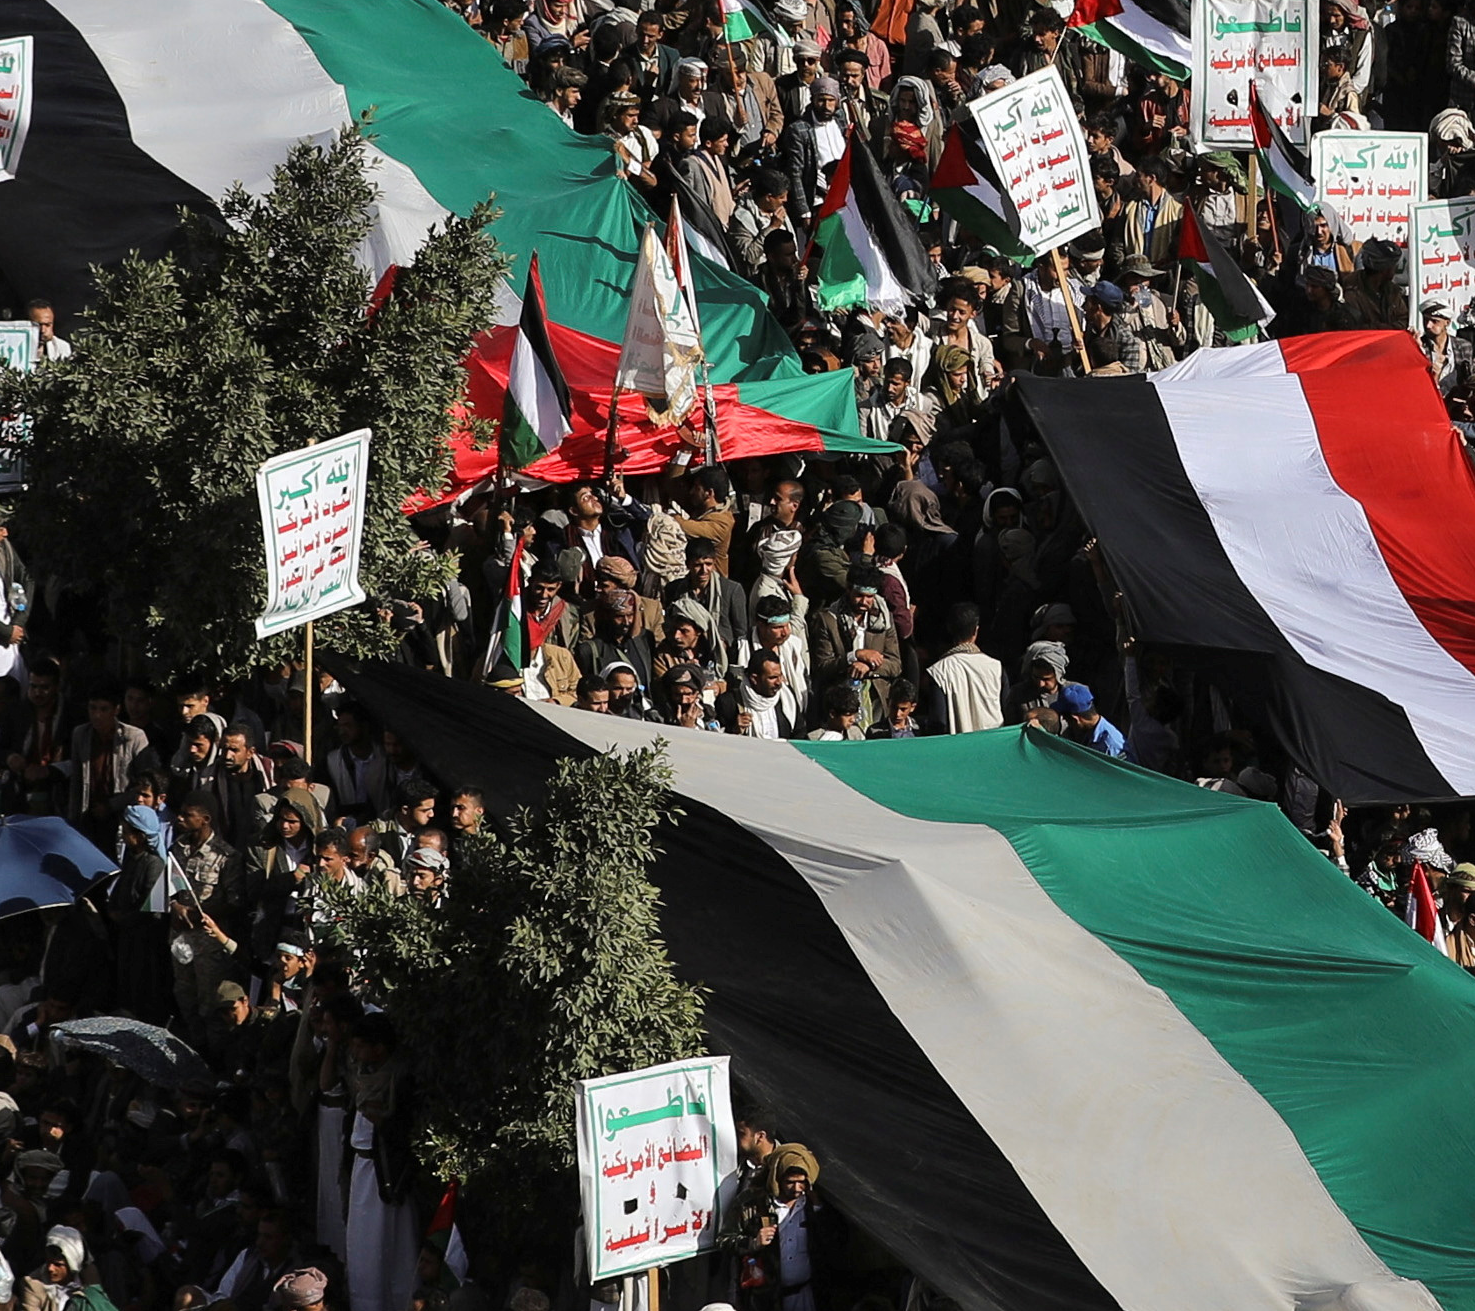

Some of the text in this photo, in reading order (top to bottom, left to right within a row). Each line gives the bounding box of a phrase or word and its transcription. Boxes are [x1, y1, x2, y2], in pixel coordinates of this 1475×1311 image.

[598, 1086, 707, 1141] قاطعوا
[602, 1135, 707, 1180] البضائع الأمريكية
[605, 1209, 711, 1254] الإسرائيلية
